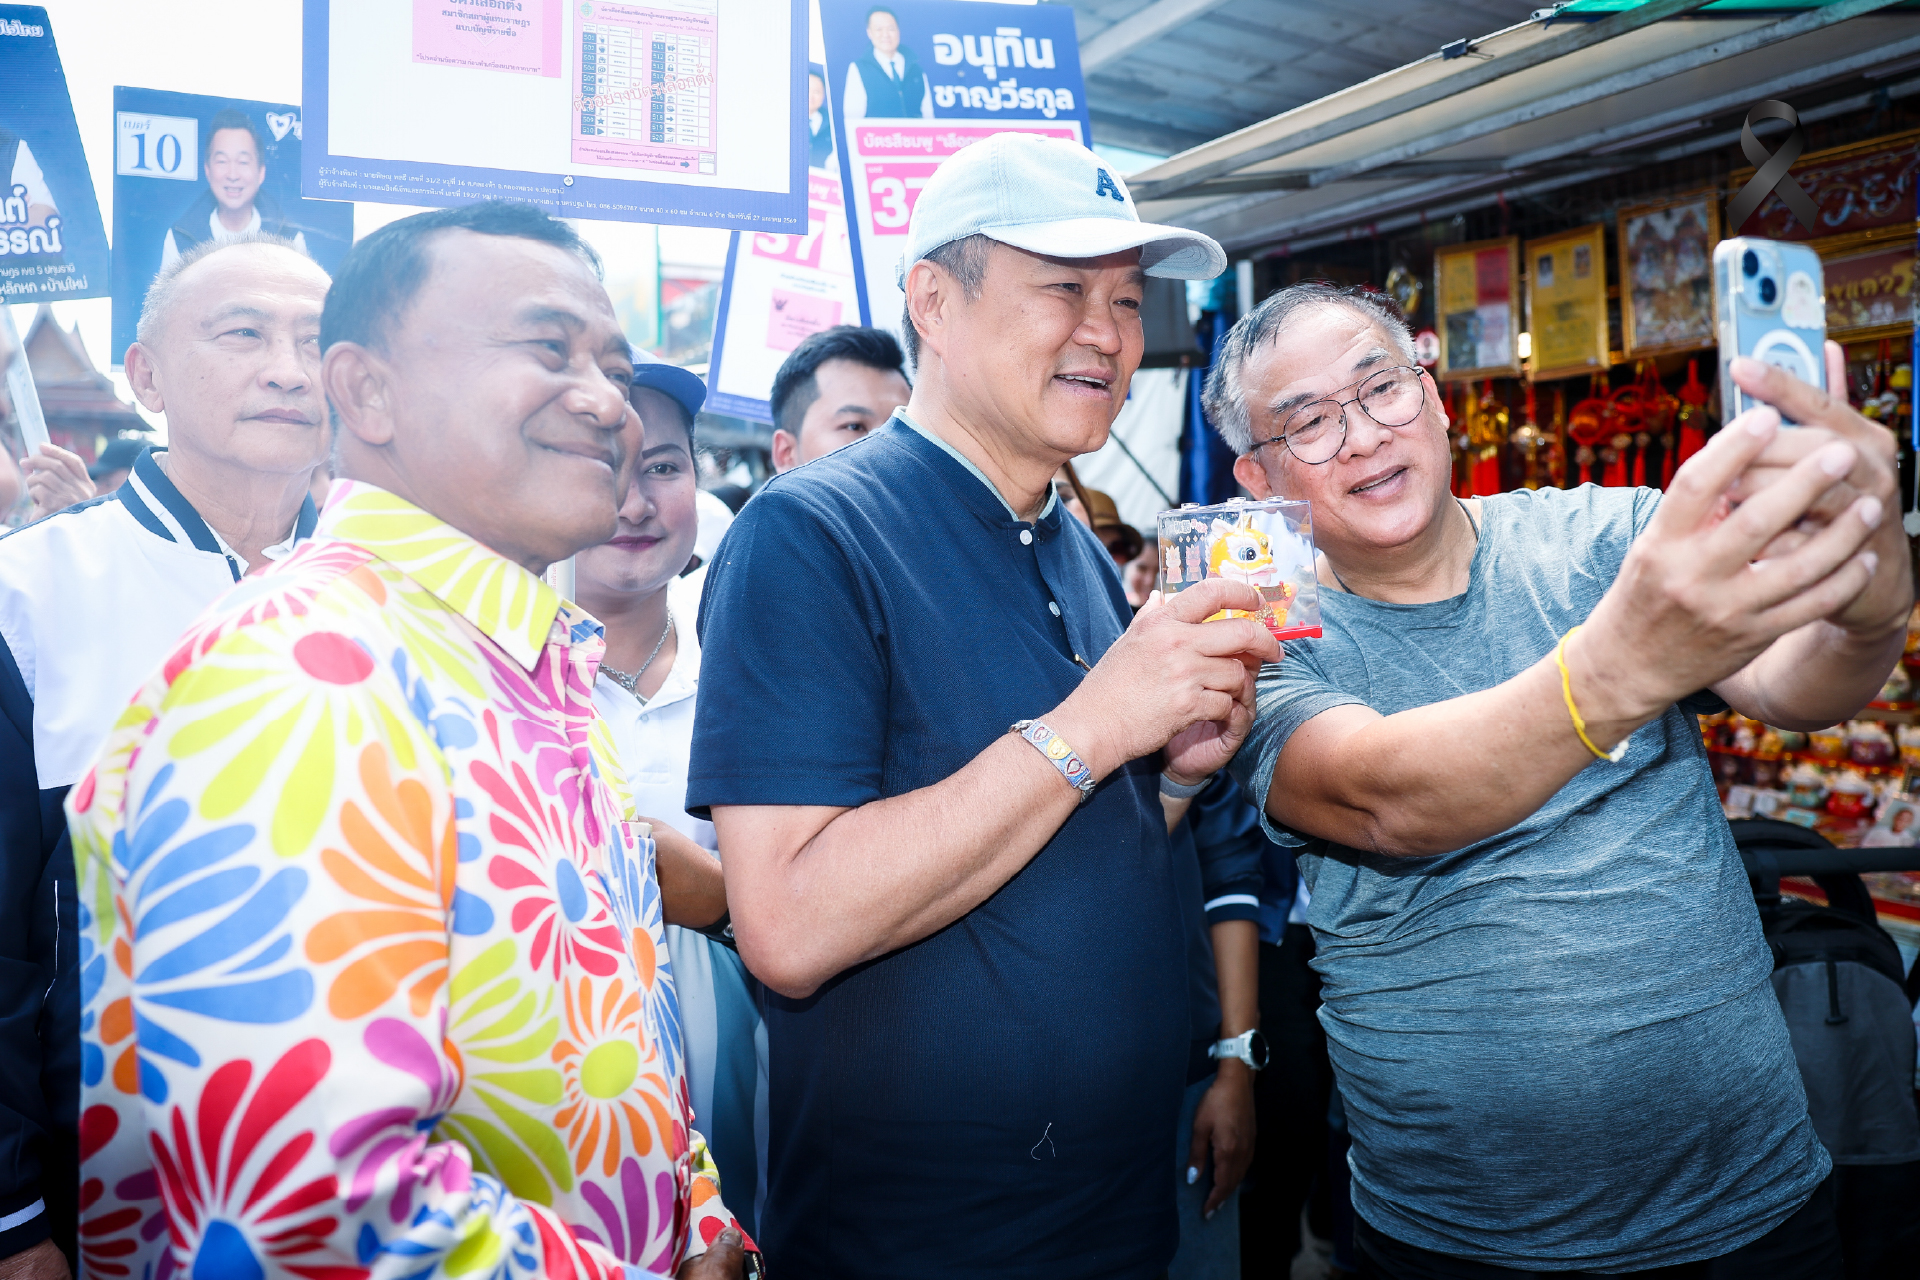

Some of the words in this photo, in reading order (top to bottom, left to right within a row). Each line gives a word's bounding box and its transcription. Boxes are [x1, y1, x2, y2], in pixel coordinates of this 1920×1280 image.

[456, 23, 517, 37] แบบบัญชีรายชื่อ
[932, 26, 1056, 81] อนุทิน
[573, 63, 715, 112] ตัวอย่างบัตรเลือกตั้ง
[933, 77, 1076, 119] ชาญวีรกูล
[130, 133, 182, 174] 10
[863, 131, 933, 152] บัตรสีชมพู
[1096, 167, 1125, 202] A
